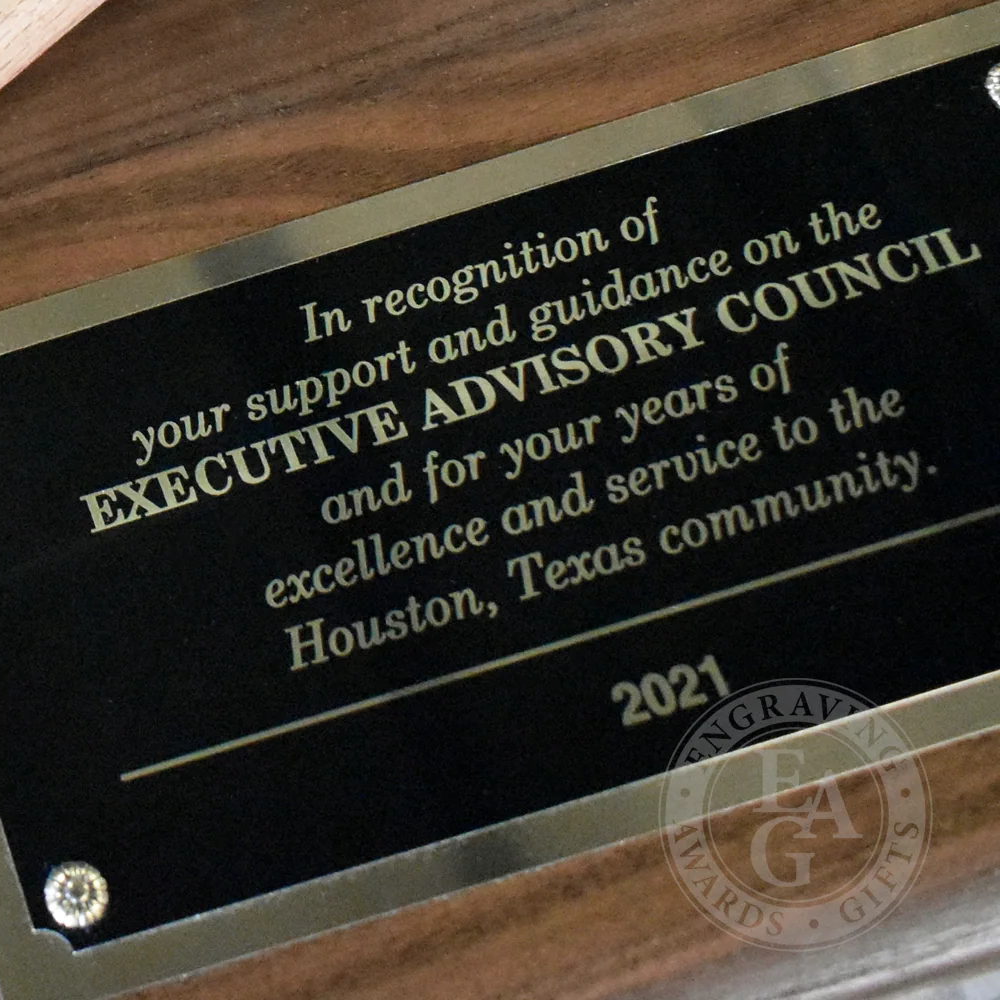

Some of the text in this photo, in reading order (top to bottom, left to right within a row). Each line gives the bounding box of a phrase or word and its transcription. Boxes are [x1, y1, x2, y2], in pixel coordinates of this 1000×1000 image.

[80, 227, 983, 532] EXECUTIVE ADVISORY COUNCIL
[131, 201, 882, 467] your support and guidance on the
[298, 196, 659, 343] In recognition of
[265, 386, 905, 609] excellence and service to the
[321, 342, 791, 524] and for your years of
[284, 449, 938, 671] Houston, Texas community.
[611, 654, 731, 727] 2021
